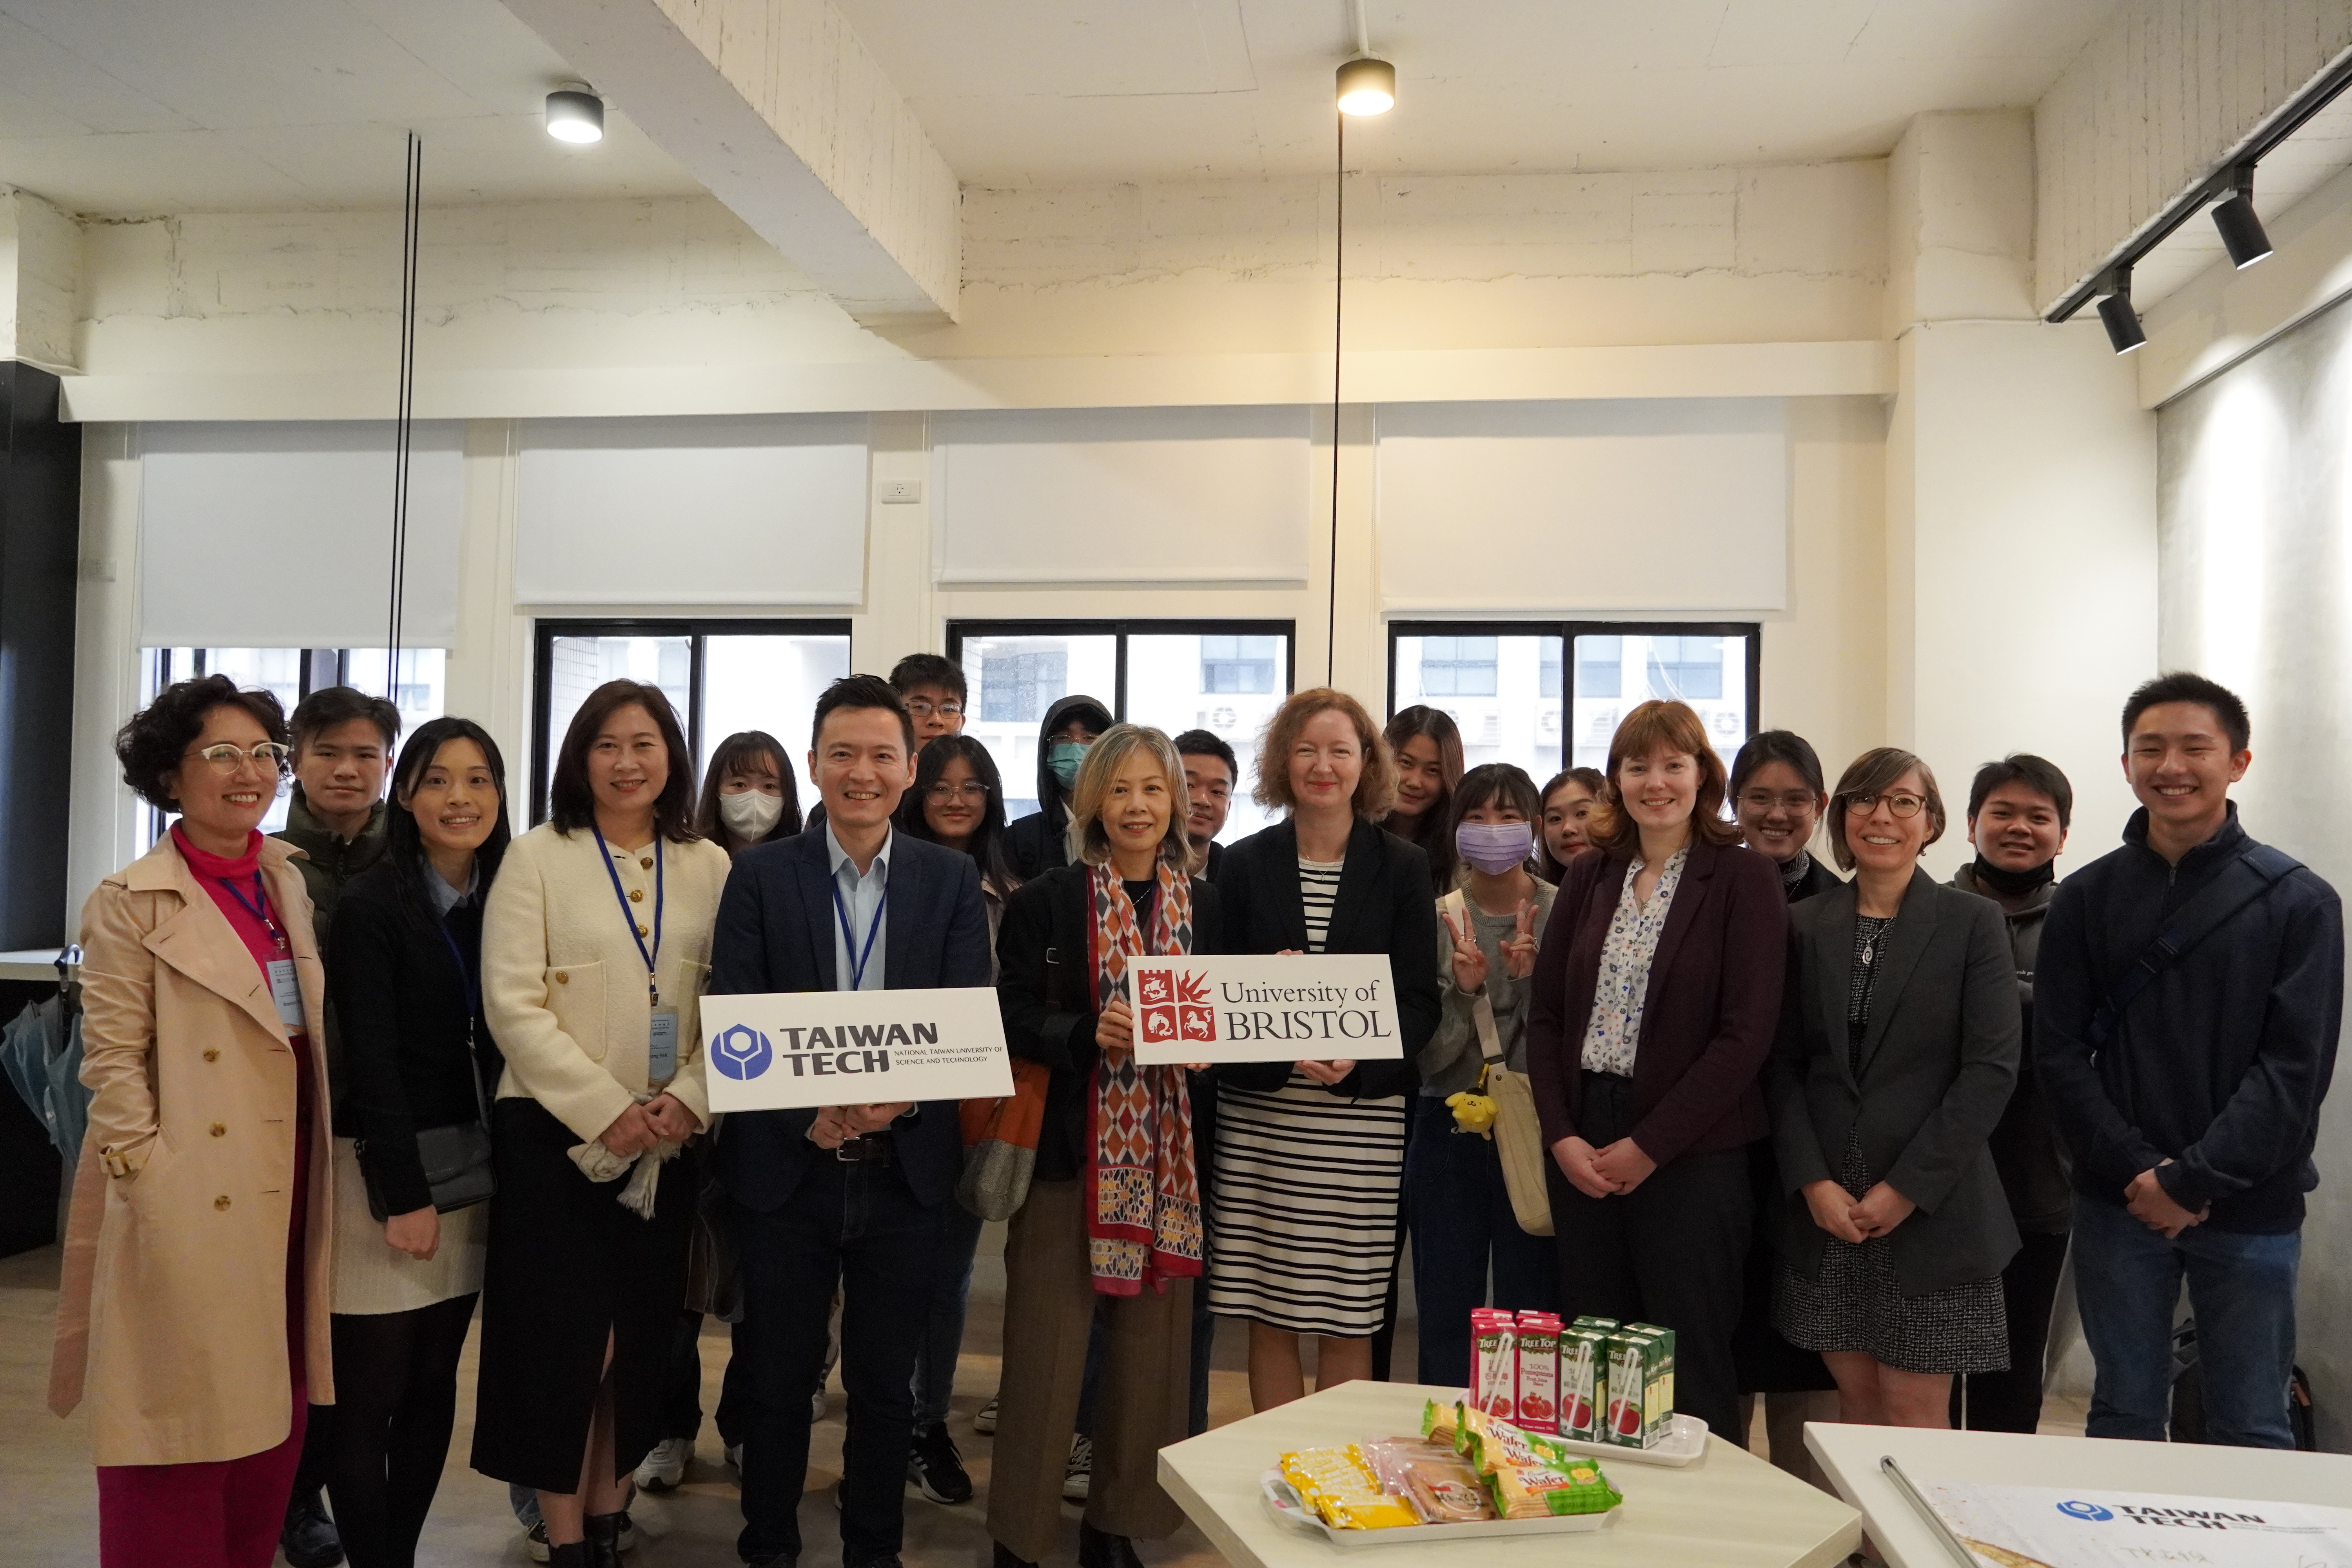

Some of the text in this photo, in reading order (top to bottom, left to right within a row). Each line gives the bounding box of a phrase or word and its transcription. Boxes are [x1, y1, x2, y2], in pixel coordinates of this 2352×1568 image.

[1220, 980, 1379, 1008] University of
[779, 1022, 938, 1050] TAIWAN
[1224, 1010, 1391, 1040] BRISTOL
[783, 1050, 890, 1076] TECH
[1520, 1338, 1556, 1347] TREE TOP
[1486, 1426, 1527, 1449] Wafer
[1518, 1475, 1565, 1486] Wafer
[2112, 1504, 2266, 1523] TAIWAN
[2122, 1514, 2227, 1530] TECH
